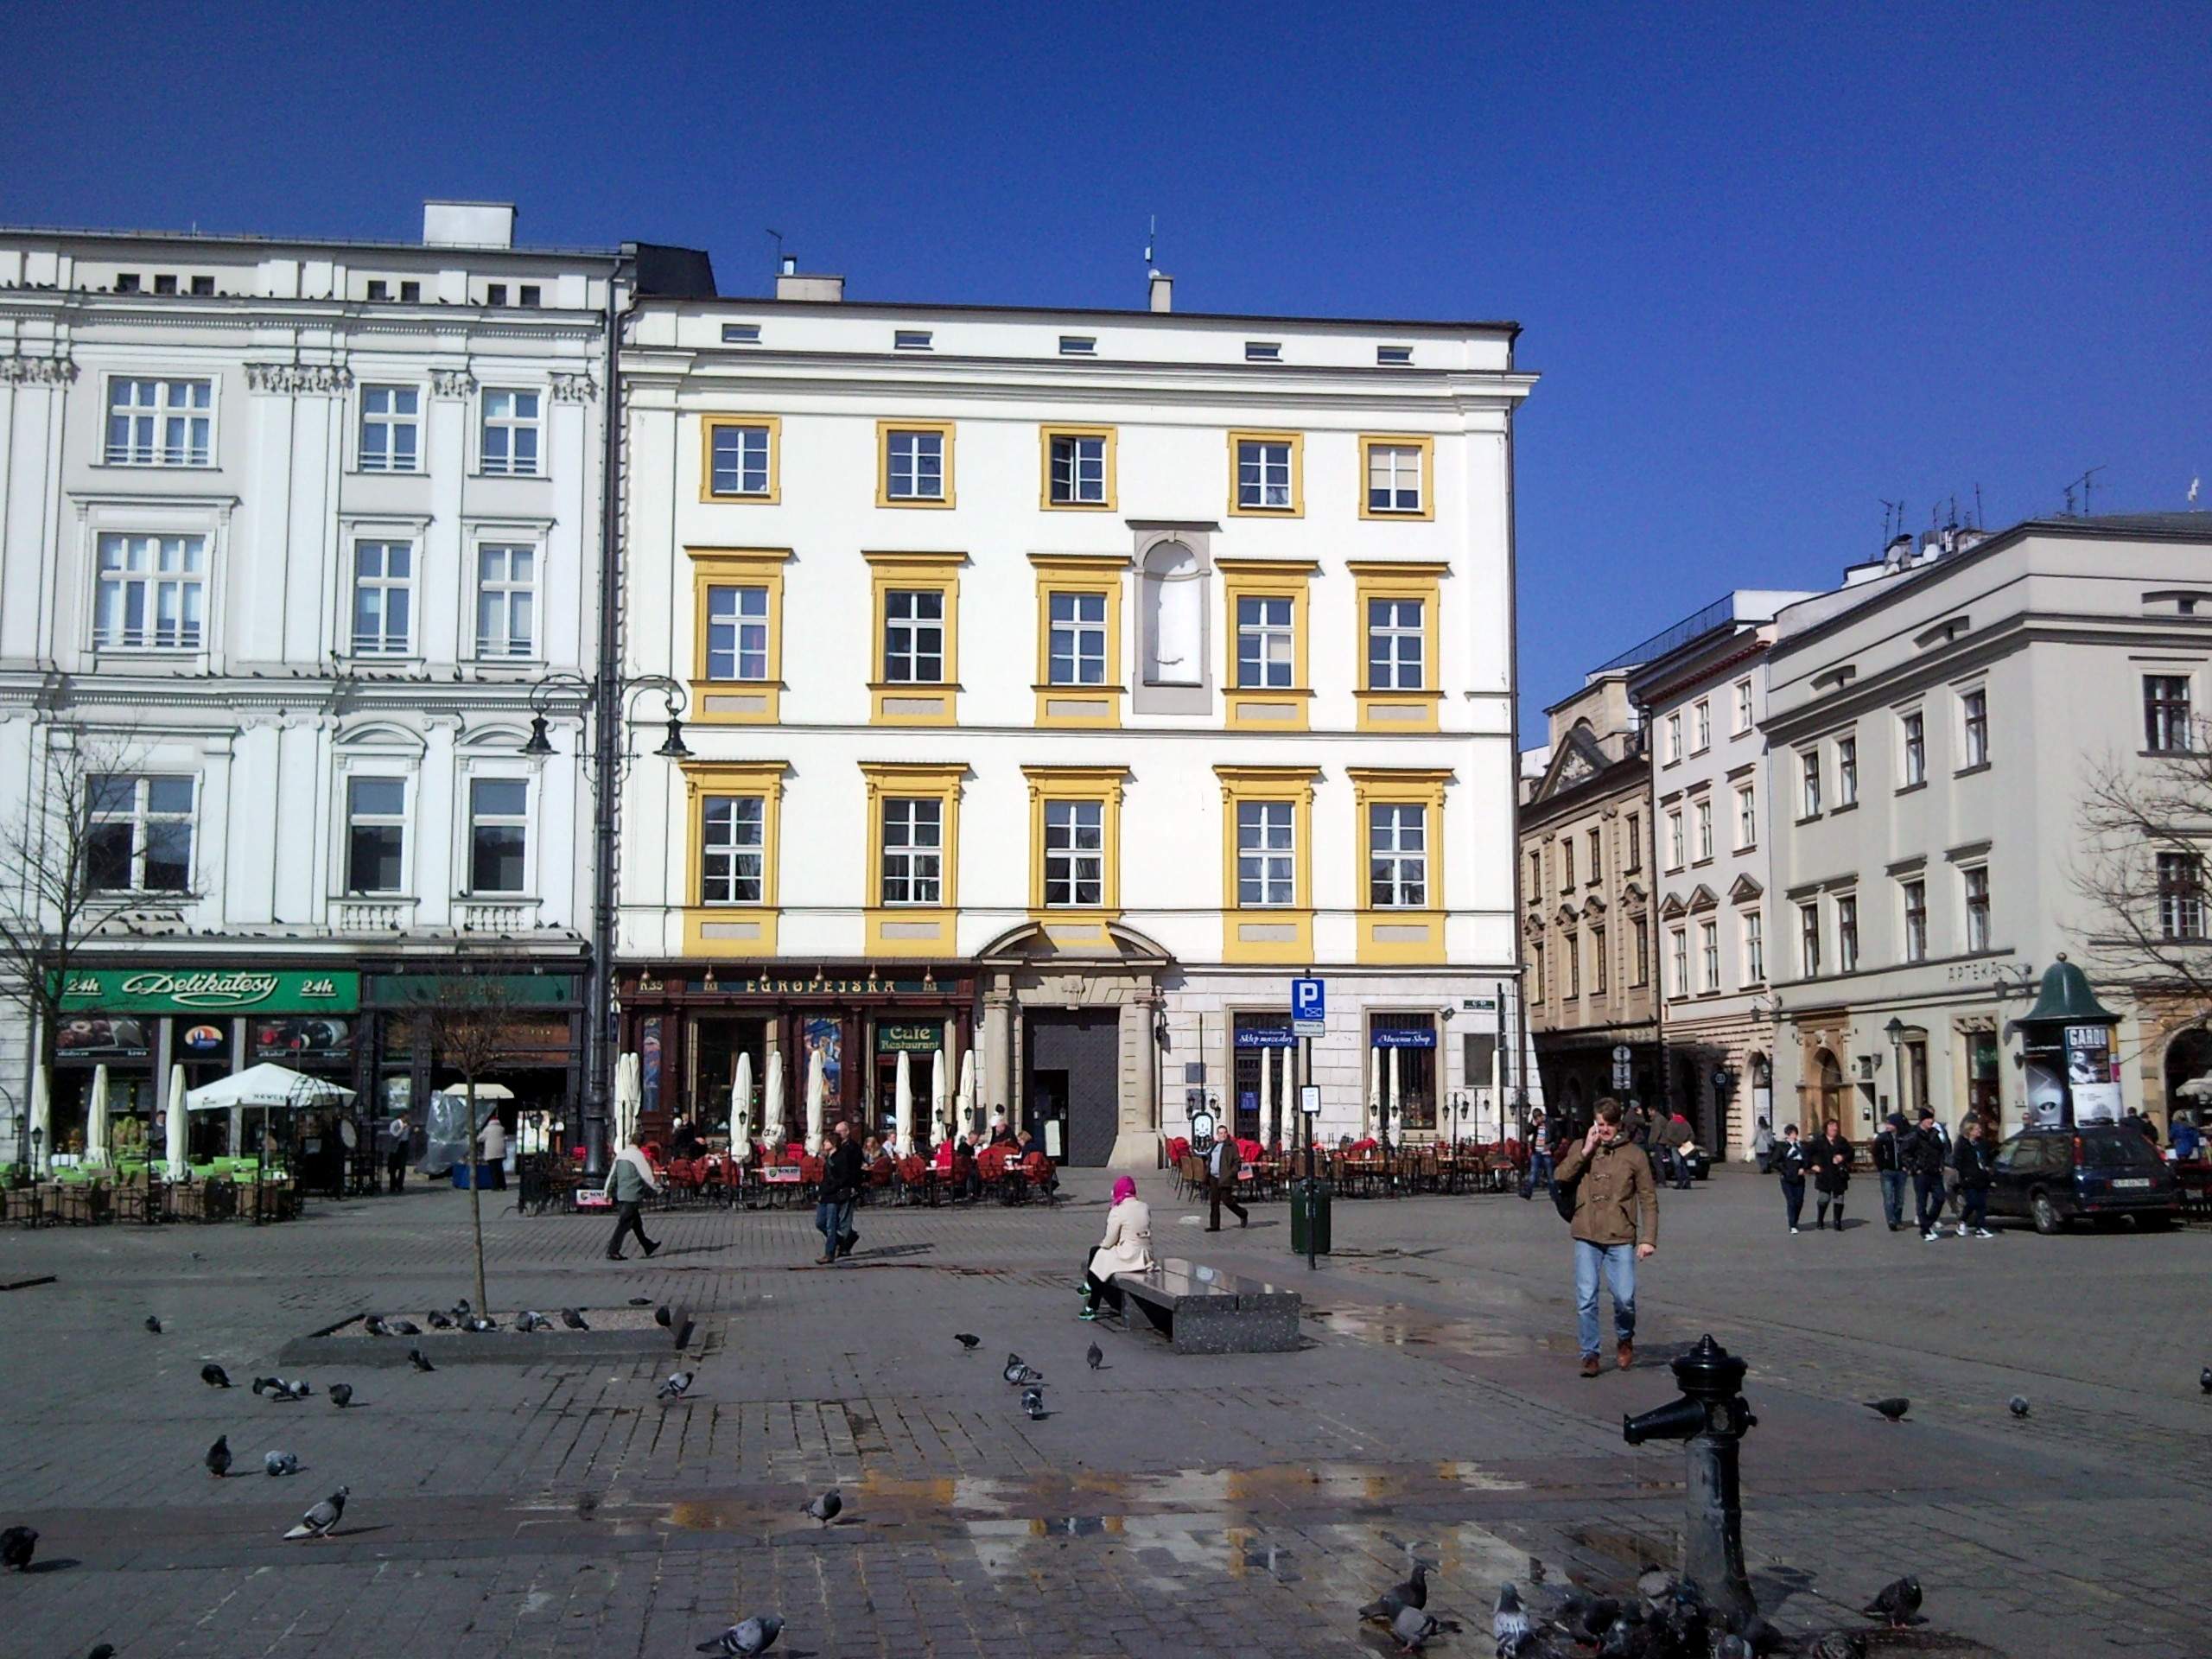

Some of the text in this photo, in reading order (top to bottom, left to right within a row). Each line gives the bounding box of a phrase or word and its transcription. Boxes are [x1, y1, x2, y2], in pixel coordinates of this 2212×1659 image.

[67, 978, 99, 993] 24h
[122, 972, 278, 1006] Delikatesy
[302, 978, 334, 993] 24h
[746, 980, 895, 993] EUROPEJSKA
[1300, 982, 1318, 1008] P
[881, 1040, 939, 1049] Restaurant
[1239, 1033, 1259, 1045] Sklep
[2069, 1029, 2107, 1046] GAROU
